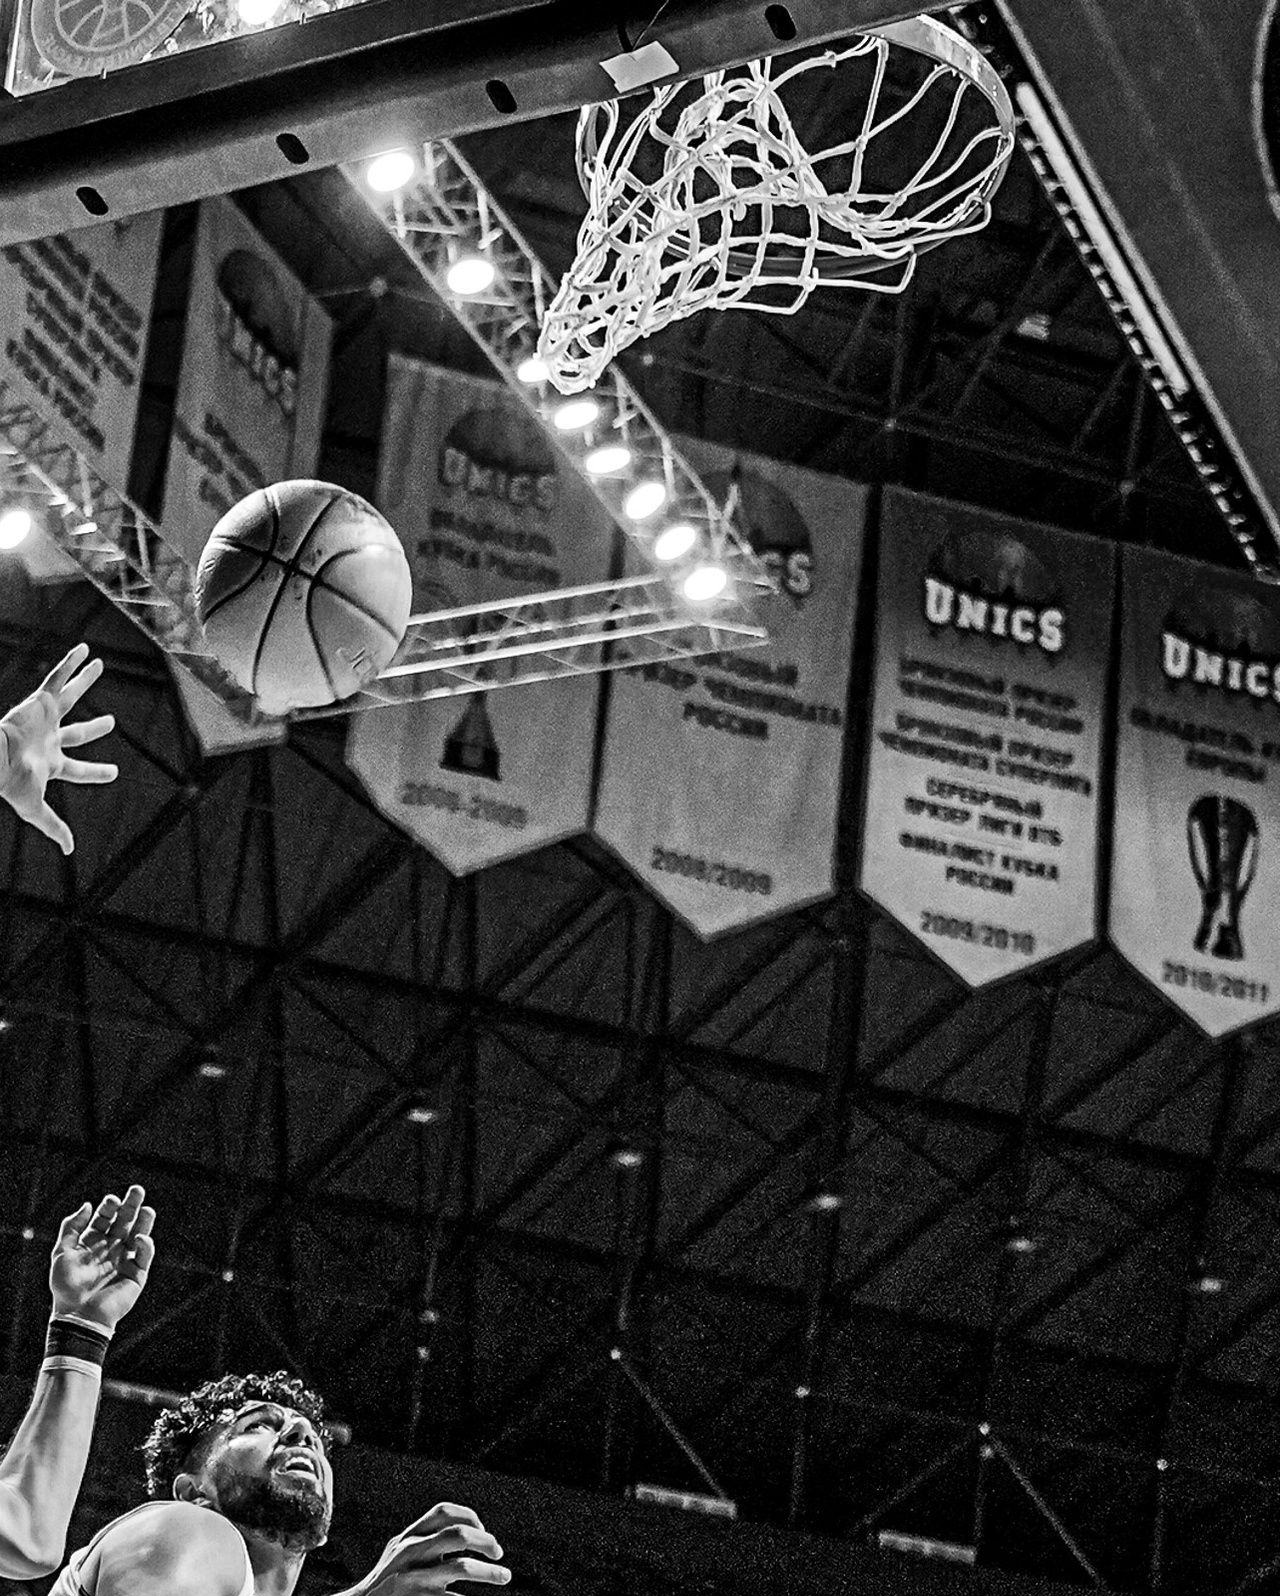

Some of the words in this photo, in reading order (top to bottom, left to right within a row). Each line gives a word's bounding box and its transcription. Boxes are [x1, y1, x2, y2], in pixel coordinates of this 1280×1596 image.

[443, 448, 558, 507] UNICS
[925, 577, 1064, 652] UNICS
[1162, 631, 1280, 704] UNIC
[921, 910, 1036, 956] 2009/2010
[1162, 960, 1270, 1005] 2010/2011
